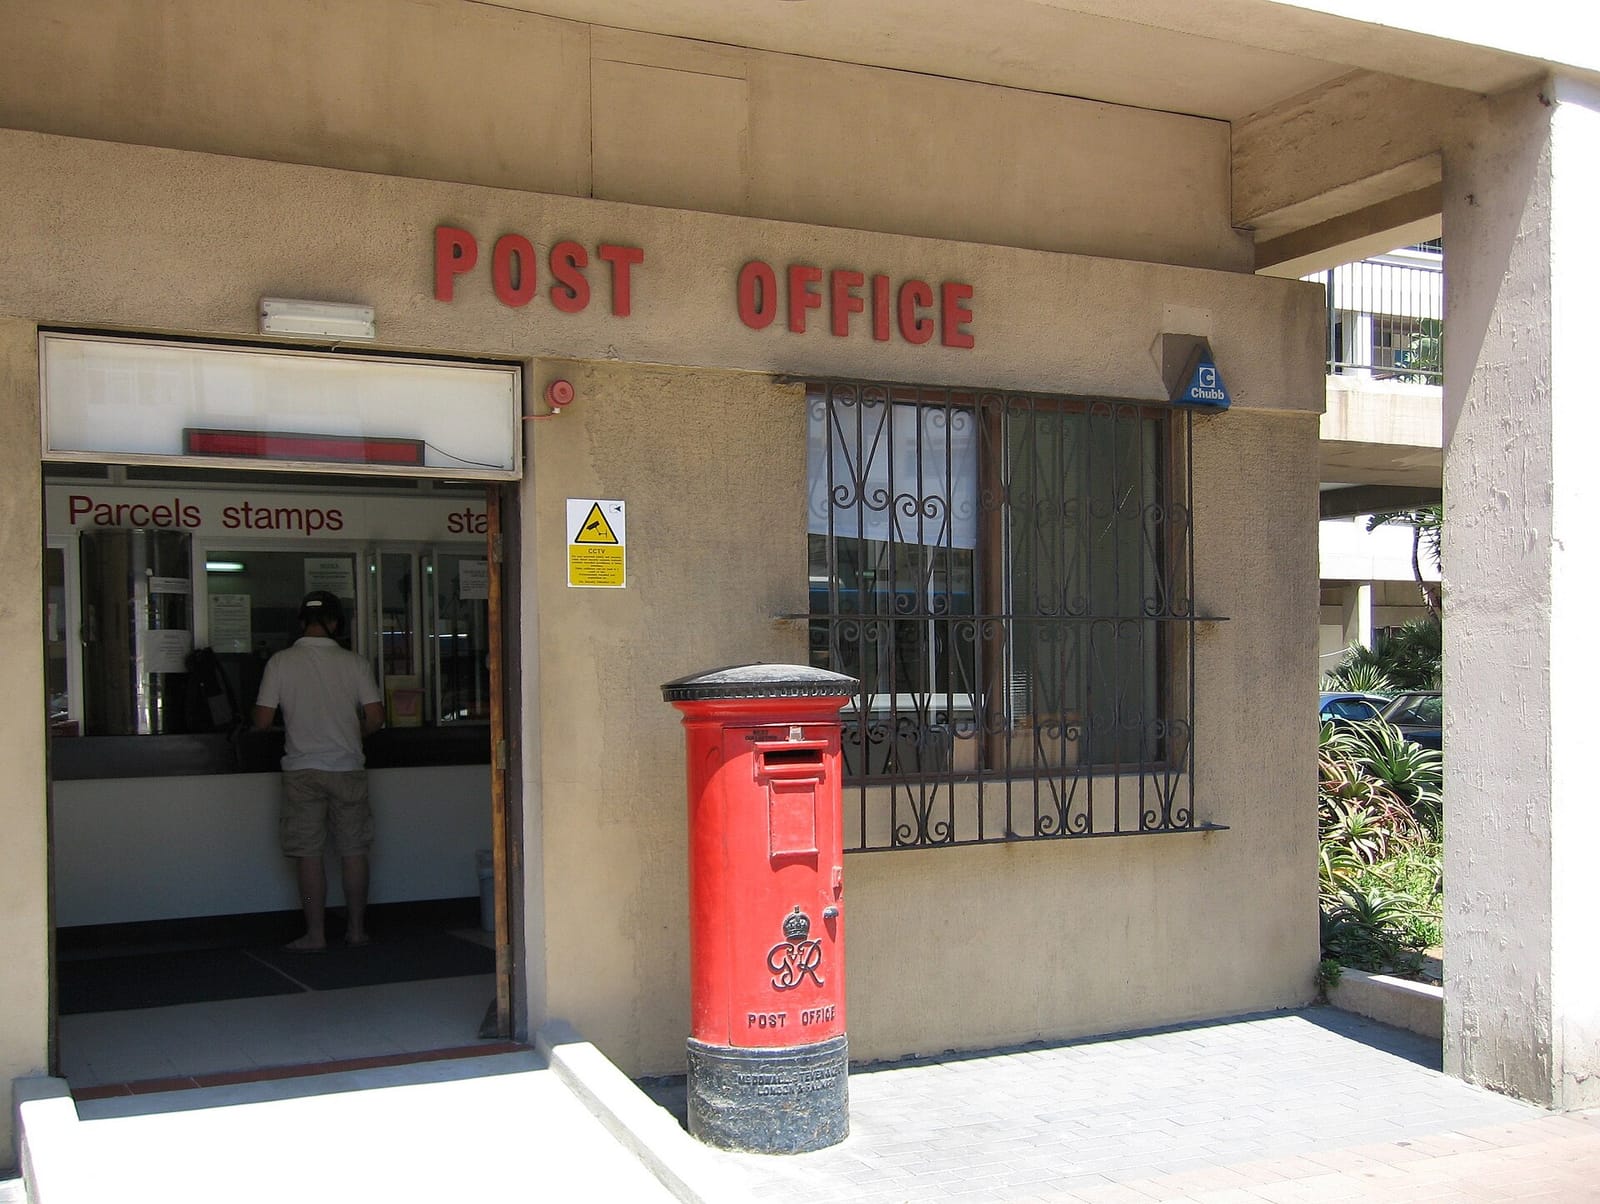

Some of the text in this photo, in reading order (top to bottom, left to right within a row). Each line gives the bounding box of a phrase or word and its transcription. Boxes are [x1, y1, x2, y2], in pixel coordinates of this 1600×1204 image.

[435, 224, 975, 349] POST OFFICE
[1191, 387, 1225, 400] Chubb
[68, 495, 344, 536] Parcels stamps
[748, 1004, 836, 1028] POST OFFICE
